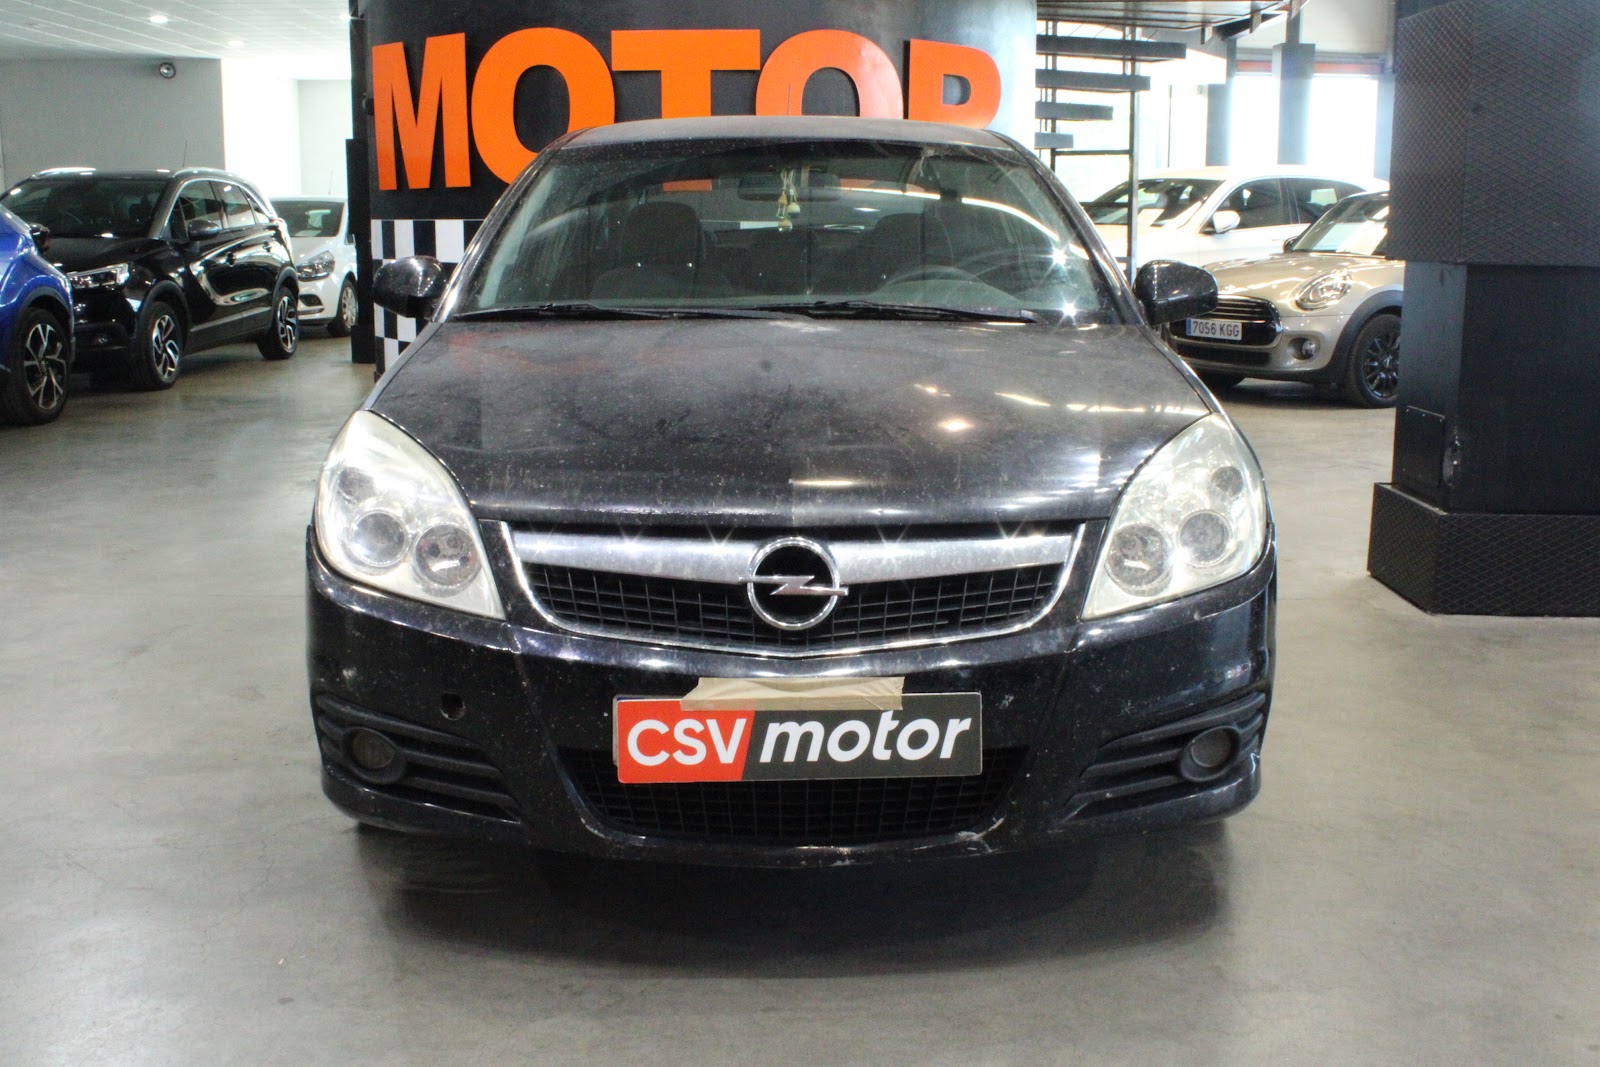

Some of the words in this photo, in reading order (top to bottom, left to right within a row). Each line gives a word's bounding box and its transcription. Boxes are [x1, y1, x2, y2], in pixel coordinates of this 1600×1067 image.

[1193, 321, 1217, 335] 7056
[1219, 324, 1240, 337] KGG
[627, 718, 746, 766] CSV
[760, 710, 972, 763] motor
